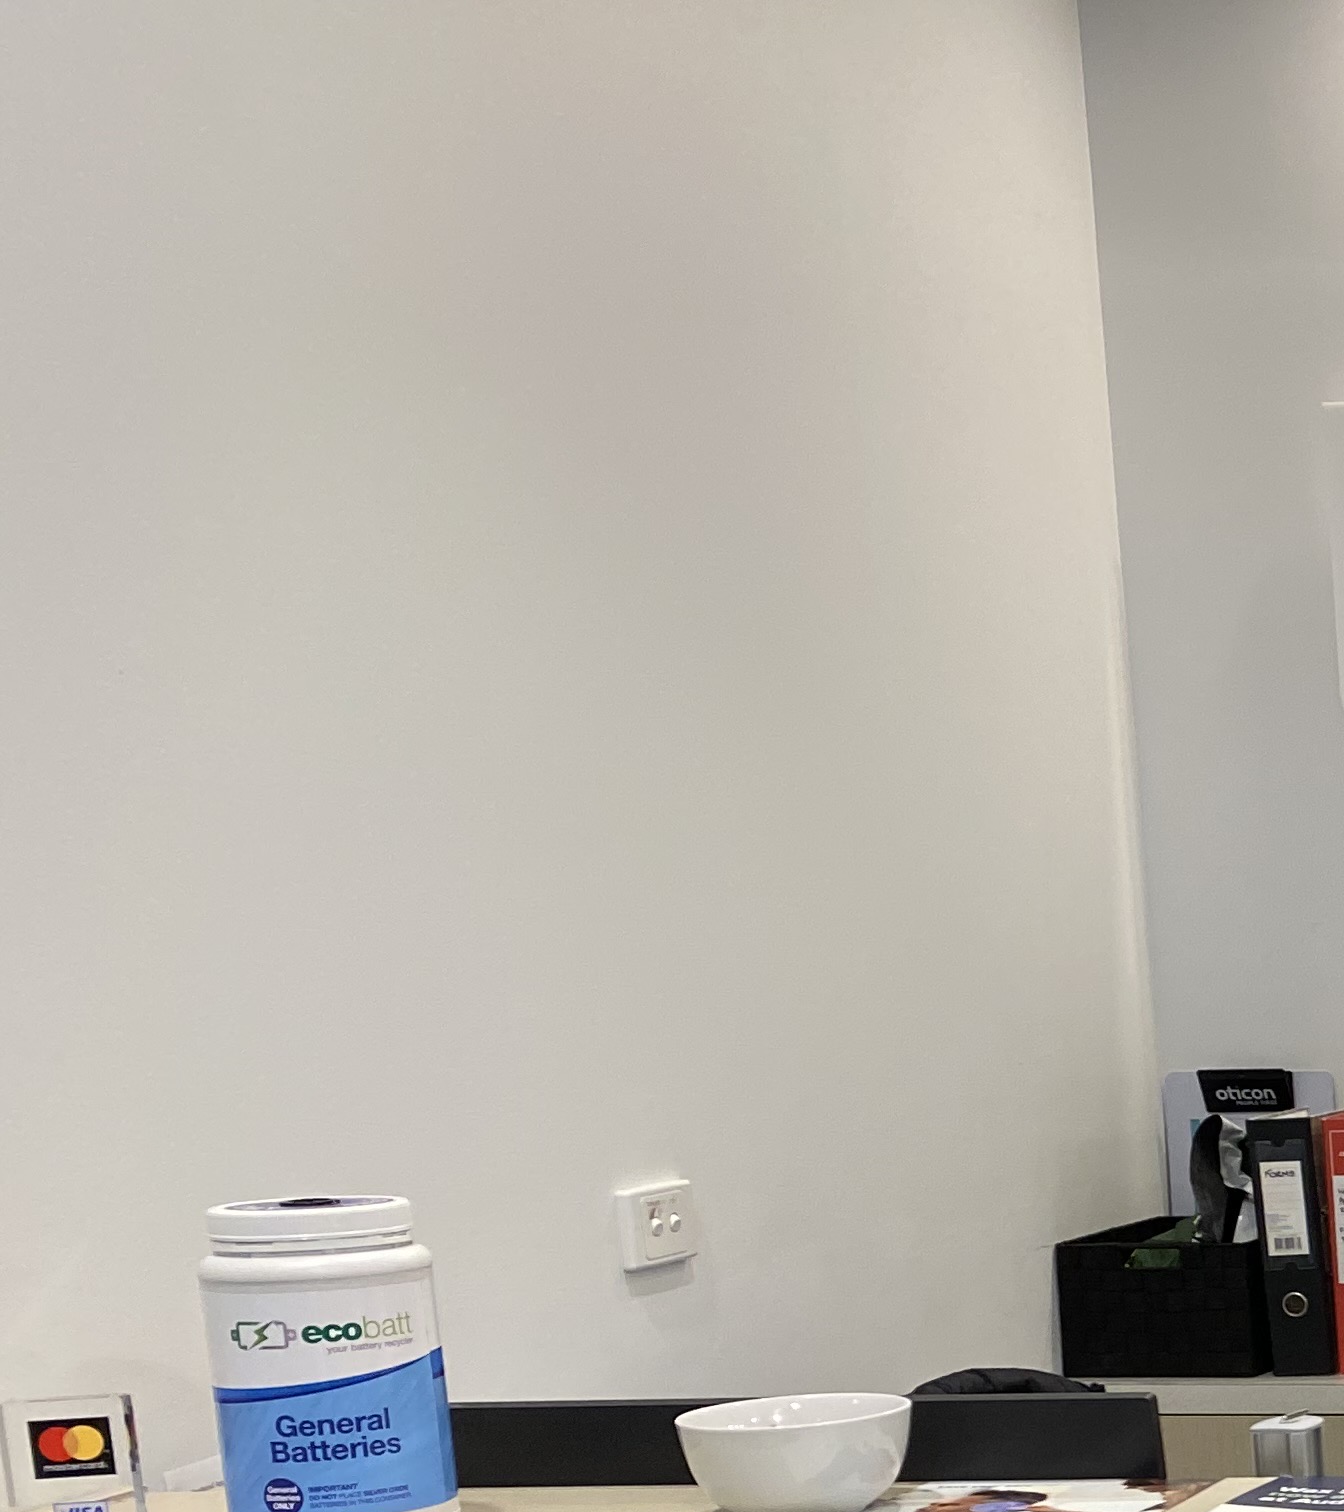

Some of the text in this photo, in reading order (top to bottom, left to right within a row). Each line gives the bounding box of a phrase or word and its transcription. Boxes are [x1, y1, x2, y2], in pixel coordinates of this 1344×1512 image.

[1215, 1085, 1277, 1101] oticon
[301, 1311, 414, 1344] ecobatt
[326, 1344, 348, 1356] your
[350, 1341, 382, 1352] battery
[275, 1407, 391, 1438] General
[269, 1435, 401, 1464] Batteries
[308, 1482, 359, 1494] IMPORTANT
[1279, 1486, 1334, 1495] Wax
